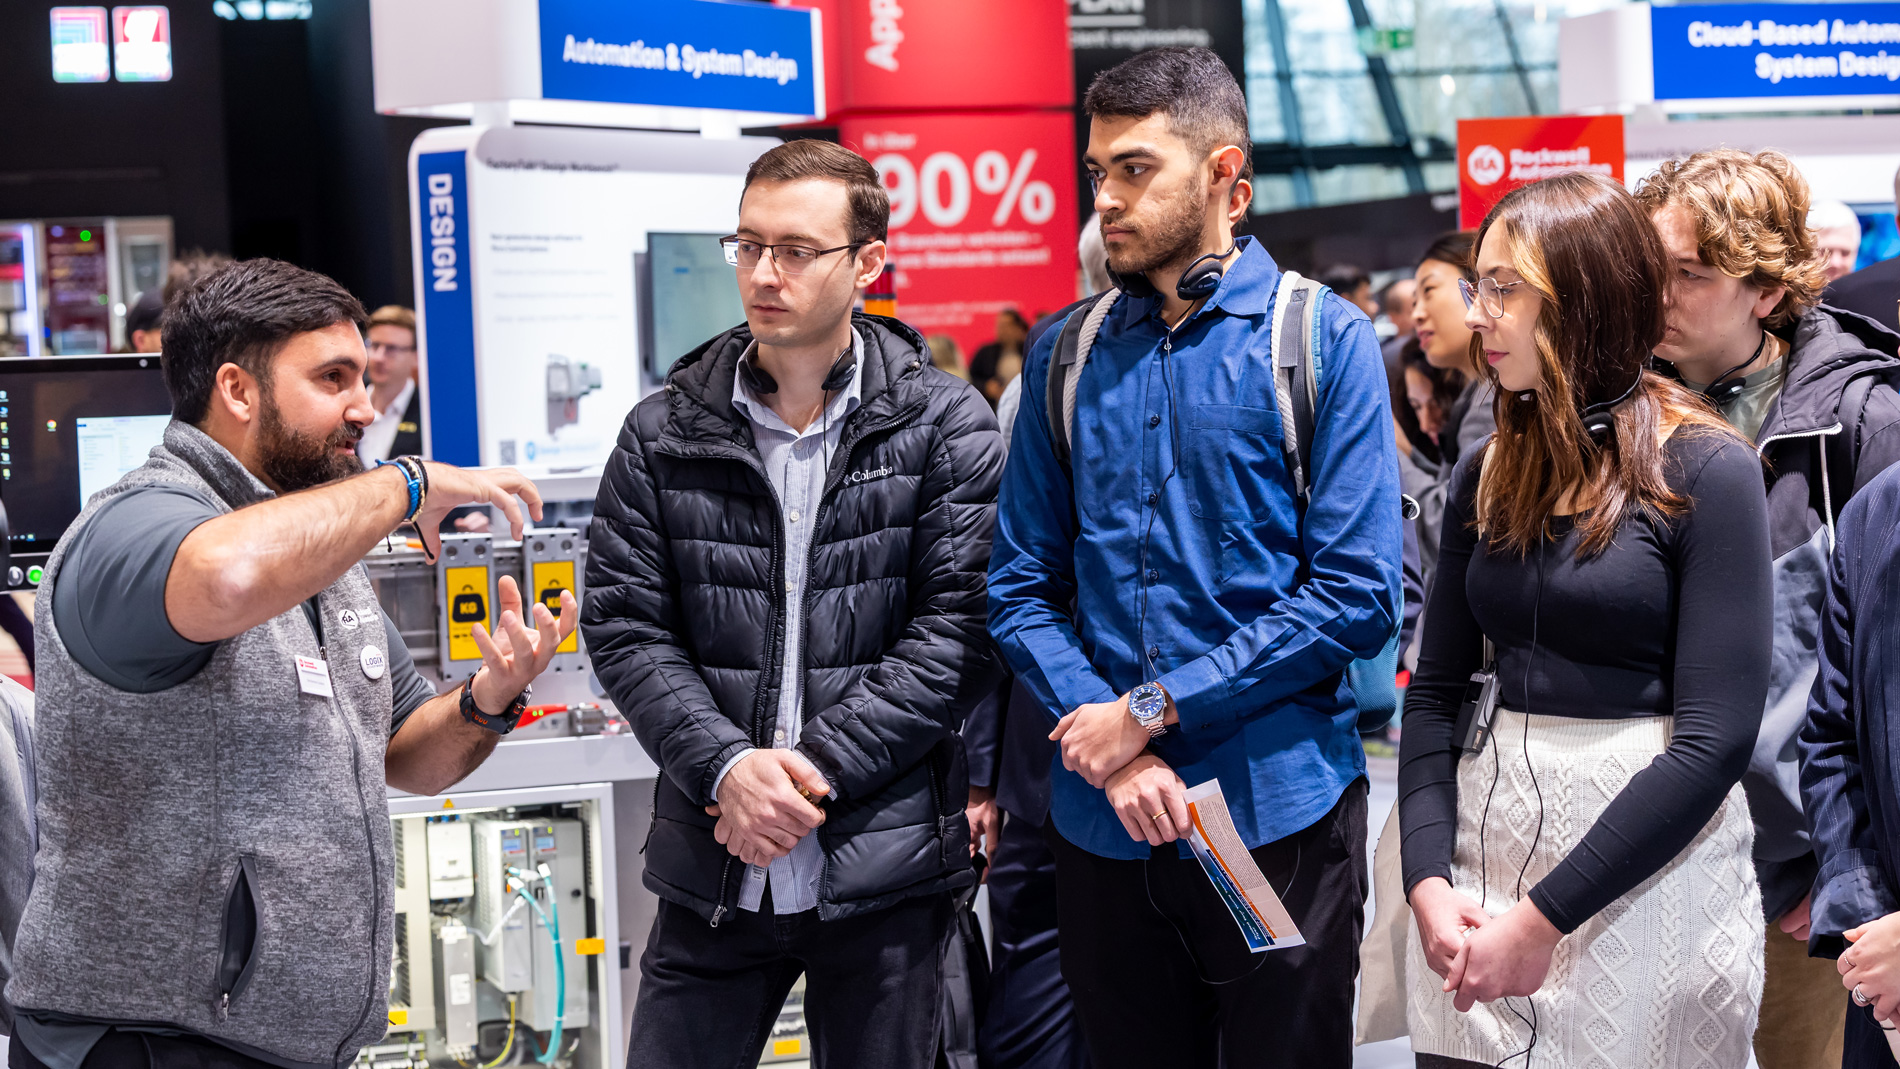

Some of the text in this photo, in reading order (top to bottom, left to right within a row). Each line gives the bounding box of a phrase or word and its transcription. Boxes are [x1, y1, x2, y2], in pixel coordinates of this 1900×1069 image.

[865, 0, 904, 72] App
[1688, 19, 1828, 47] Cloud-Based
[563, 34, 798, 86] Automation & System Design
[1755, 52, 1838, 84] System
[1510, 147, 1590, 165] Rockwell
[871, 148, 1056, 229] 90%
[428, 173, 458, 292] DESIGN
[460, 602, 478, 615] KG
[365, 657, 383, 666] LOGIX
